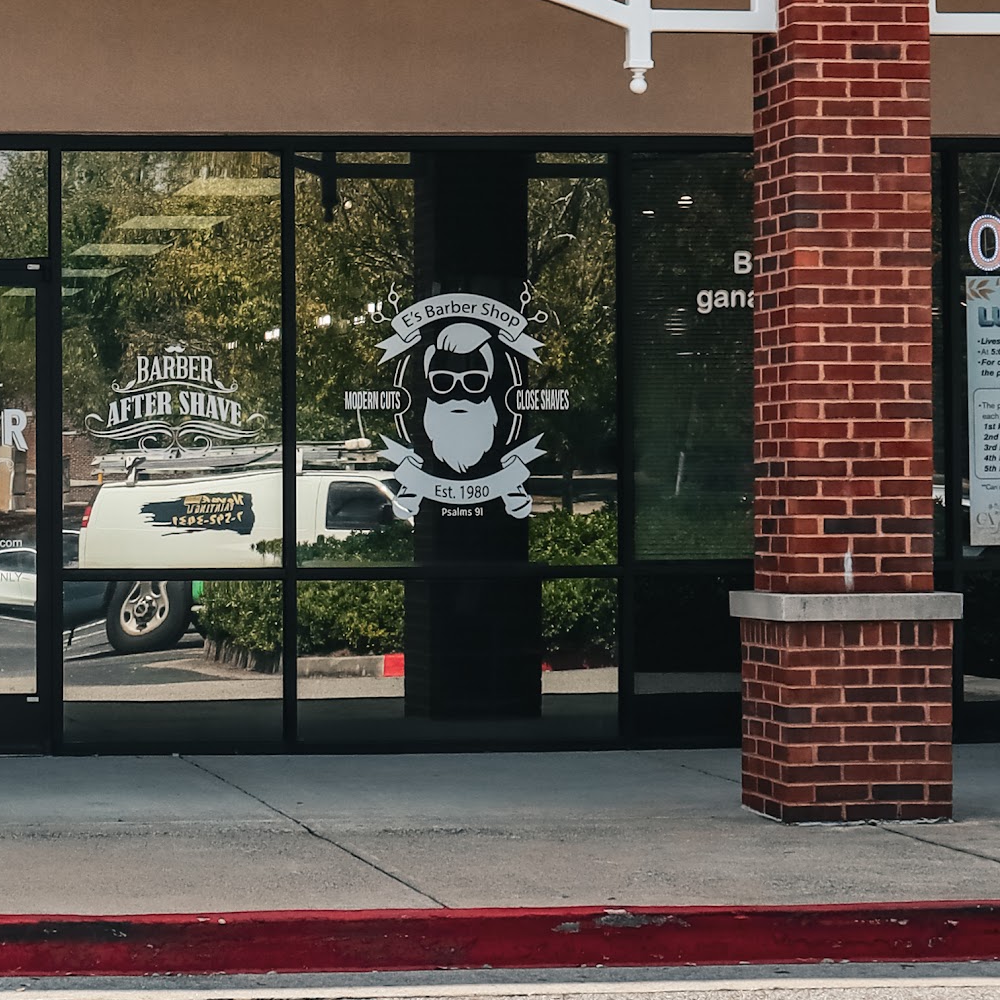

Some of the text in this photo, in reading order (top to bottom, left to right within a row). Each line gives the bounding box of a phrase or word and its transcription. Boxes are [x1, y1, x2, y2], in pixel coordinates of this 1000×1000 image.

[401, 300, 520, 328] E's Barber Shop
[136, 355, 214, 384] BARBER
[106, 391, 242, 428] AFTER SHAVE
[344, 390, 401, 410] MODERN CUTS
[516, 389, 570, 411] CLOSE SHAVES
[983, 433, 999, 441] 2nd
[984, 464, 997, 472] 5th
[434, 484, 490, 499] Est. 1980
[441, 506, 484, 517] Psalms 91
